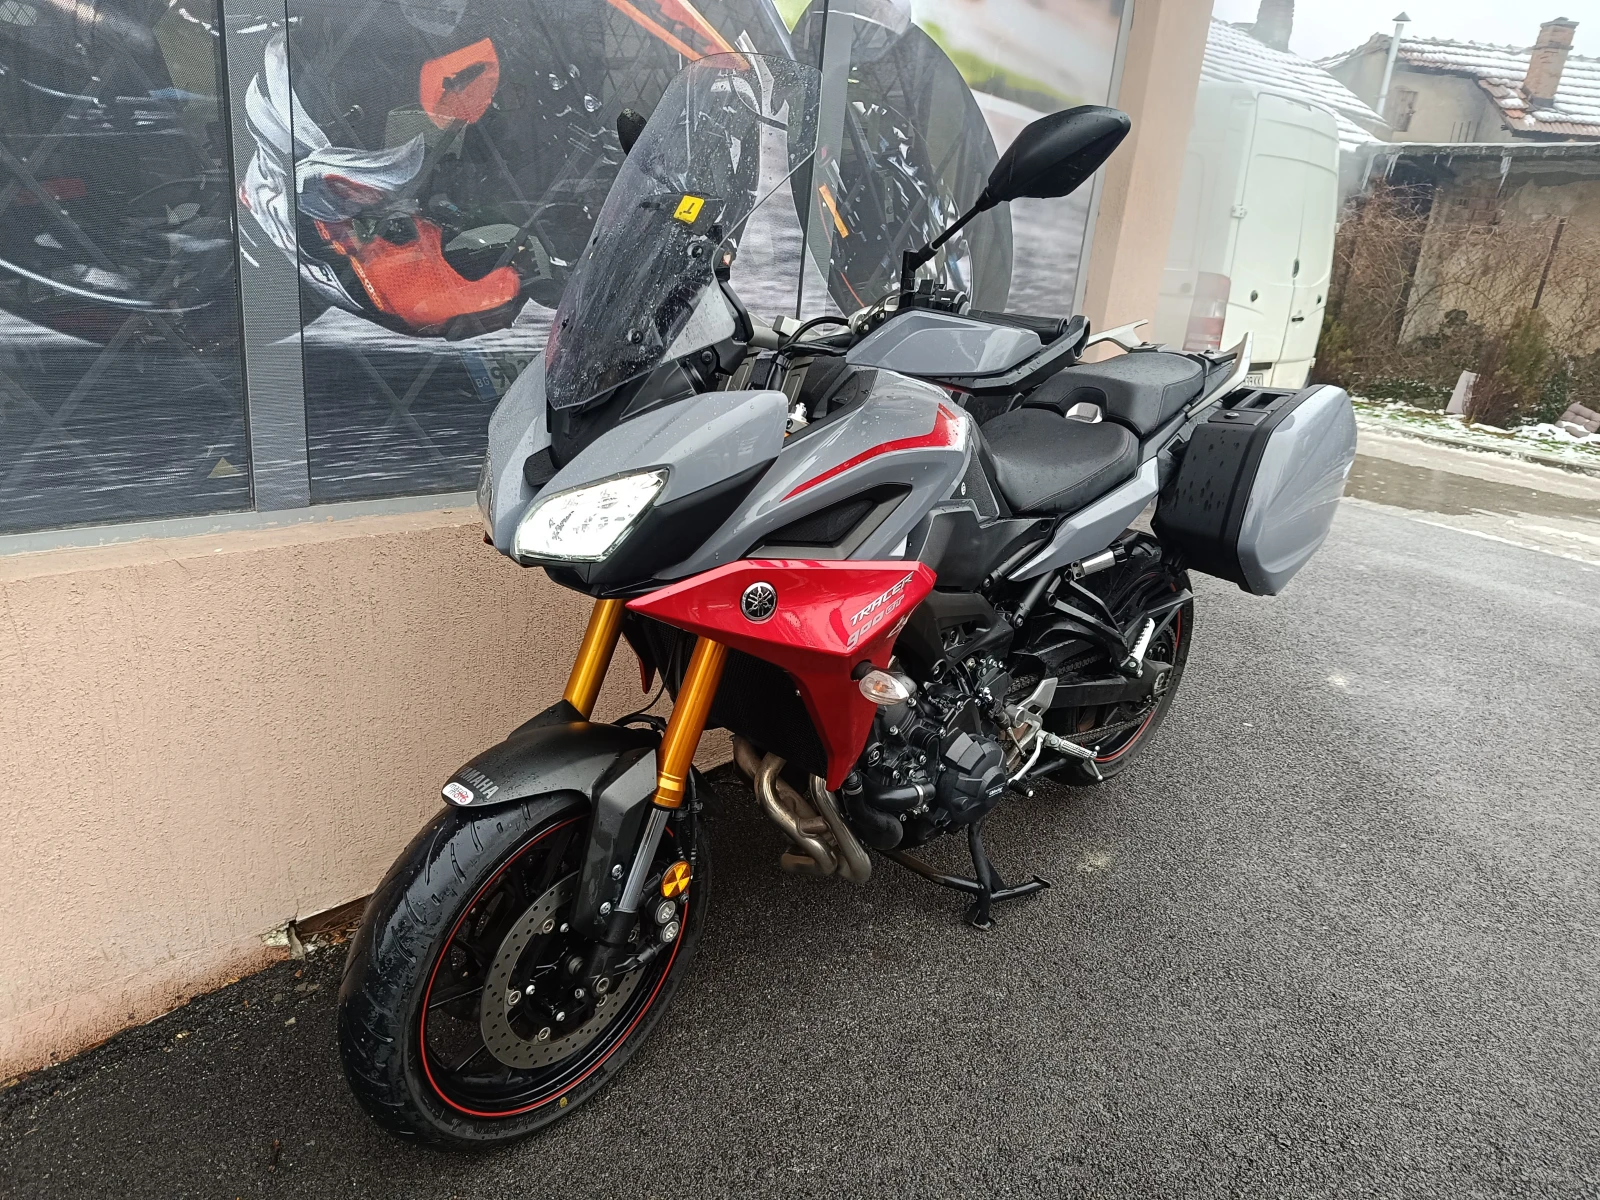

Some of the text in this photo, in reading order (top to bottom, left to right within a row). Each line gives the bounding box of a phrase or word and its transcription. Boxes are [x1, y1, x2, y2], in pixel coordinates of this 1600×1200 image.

[476, 376, 490, 388] BG
[846, 594, 905, 652] 900 GT
[850, 570, 914, 626] TRACER
